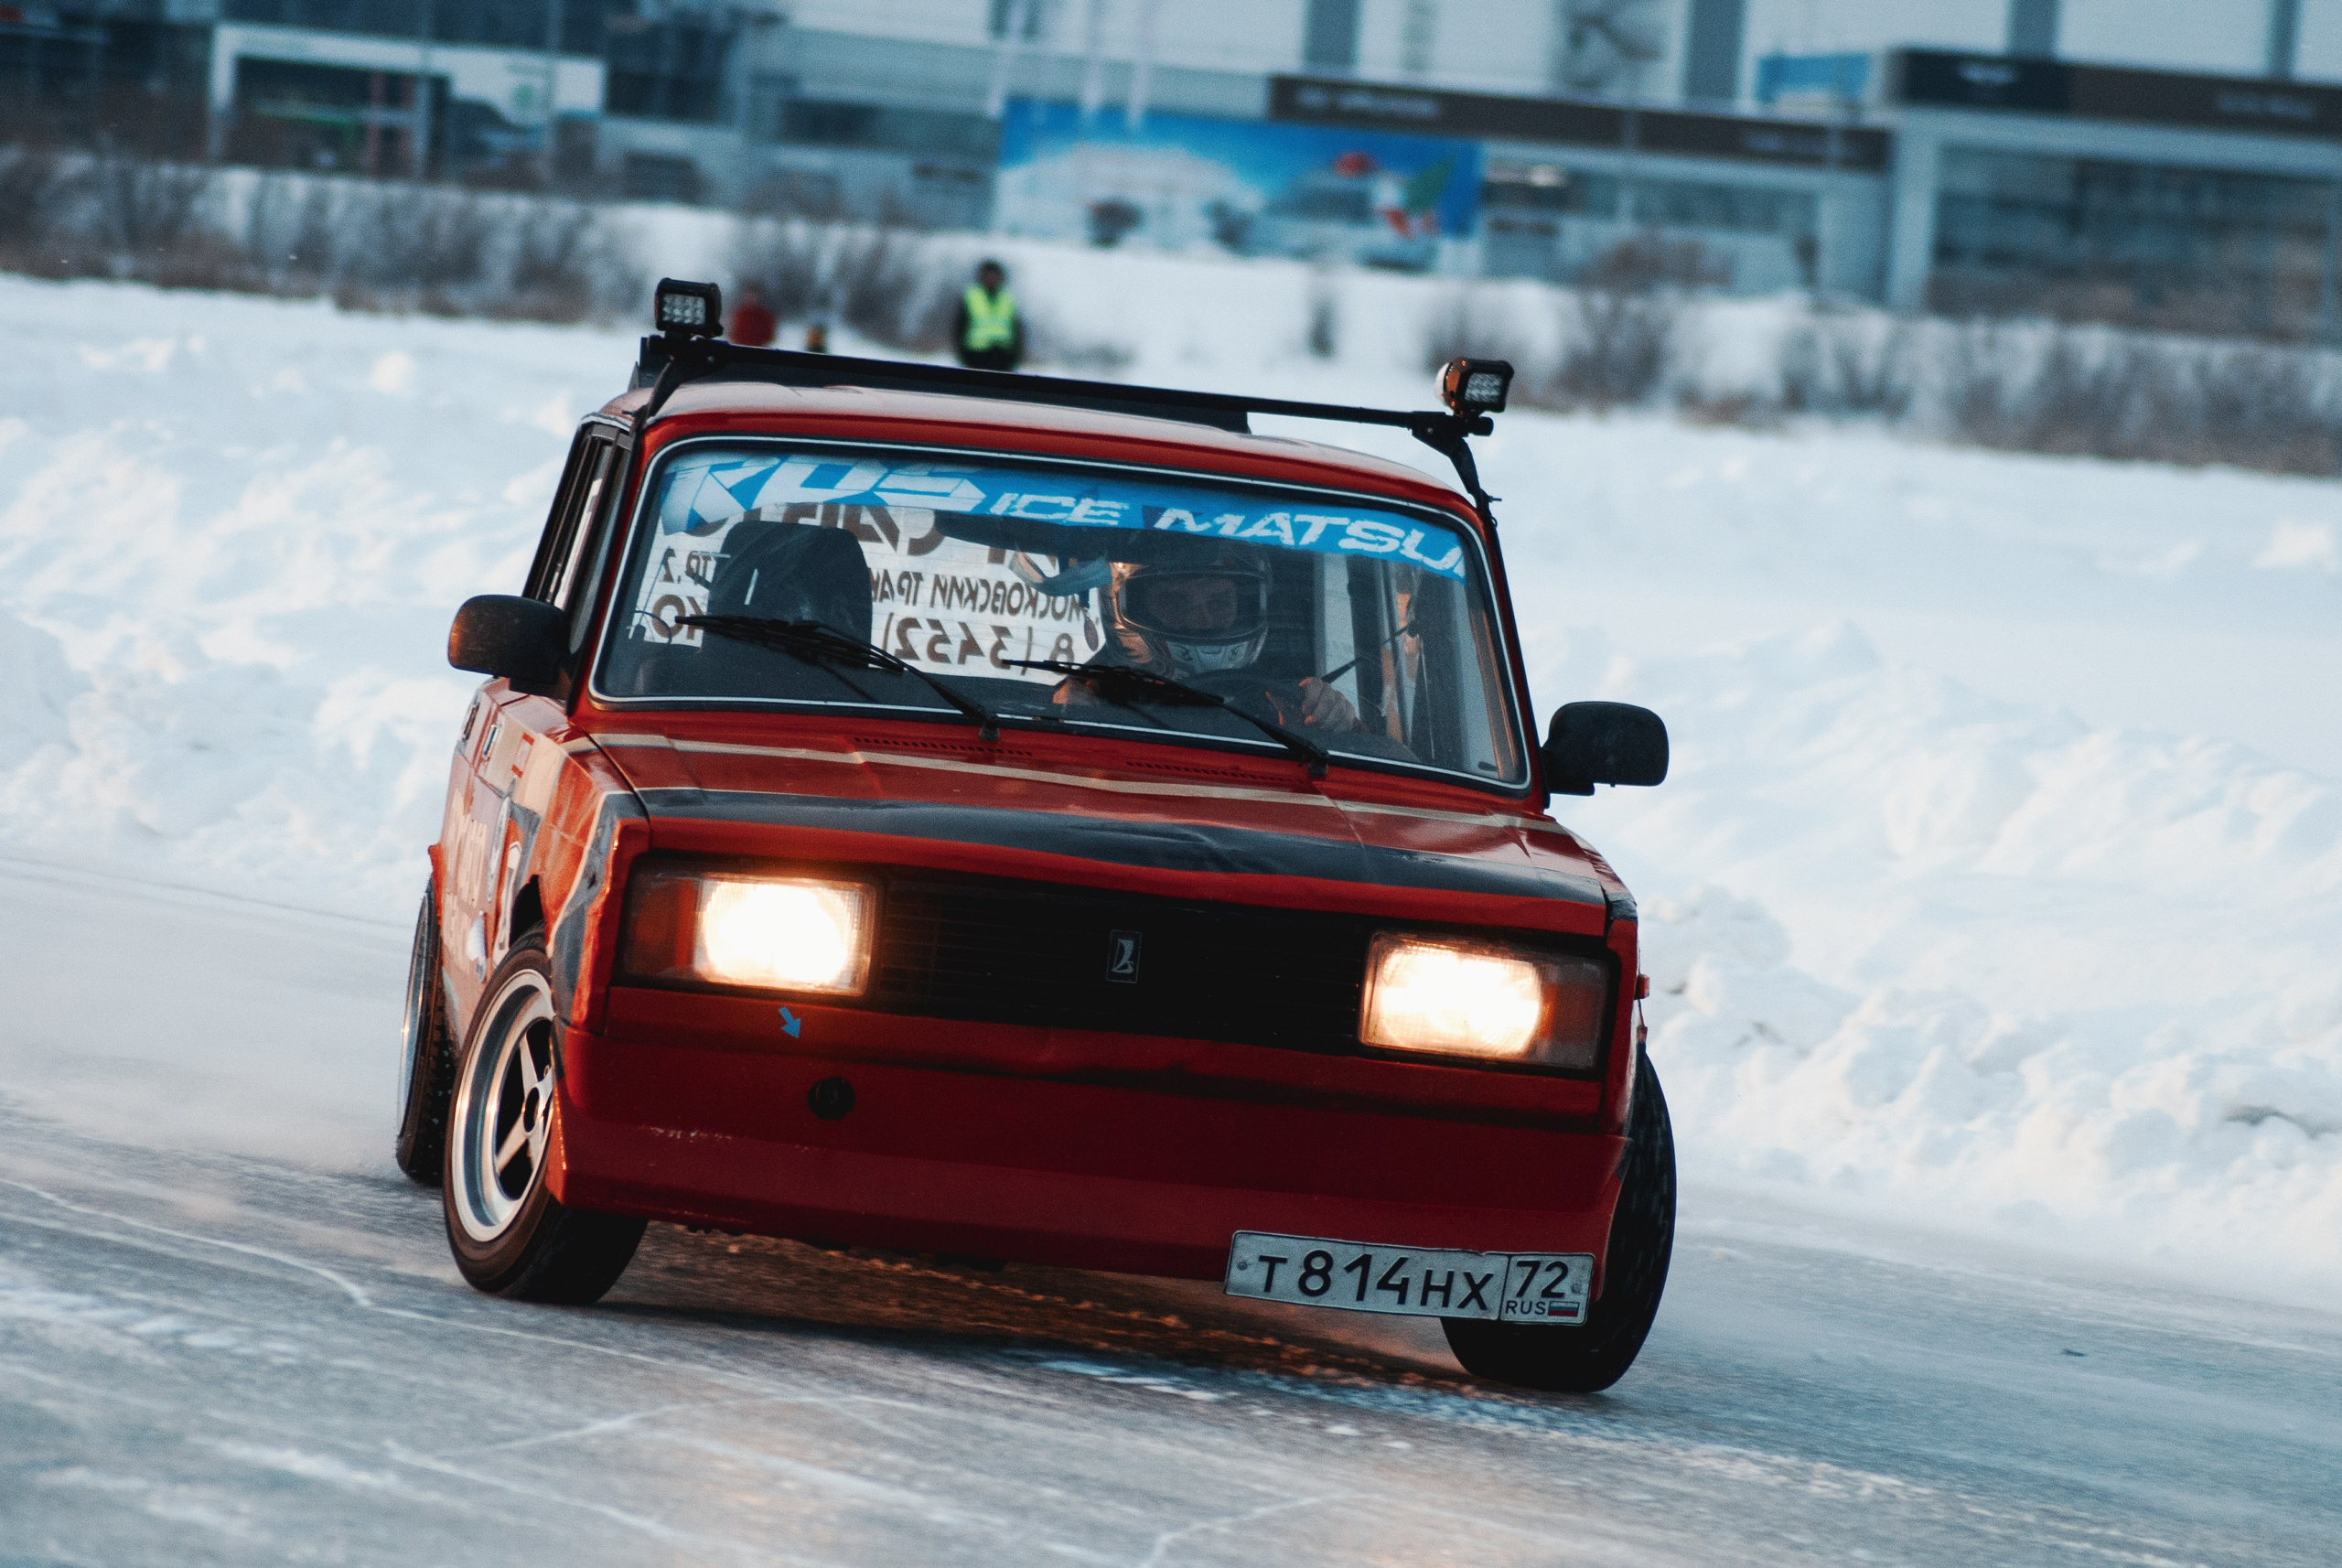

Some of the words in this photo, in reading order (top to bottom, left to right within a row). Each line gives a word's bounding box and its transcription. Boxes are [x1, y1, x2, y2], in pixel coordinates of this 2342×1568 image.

[989, 492, 1131, 527] ICE
[1152, 507, 1466, 580] MATSU
[1514, 1260, 1569, 1299] 72
[1504, 1300, 1547, 1316] RUS
